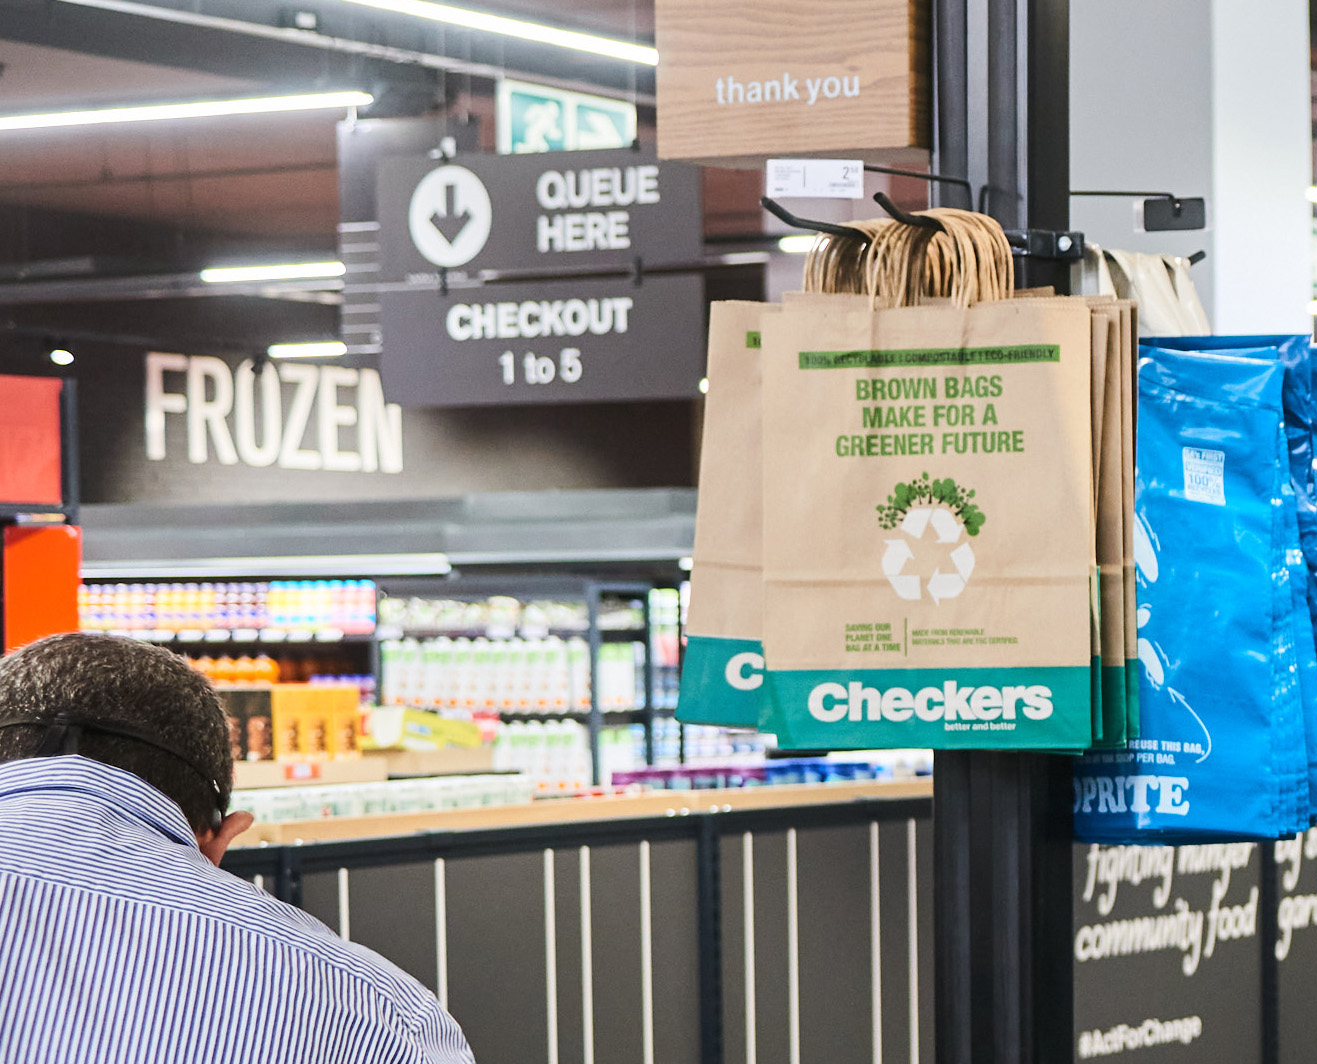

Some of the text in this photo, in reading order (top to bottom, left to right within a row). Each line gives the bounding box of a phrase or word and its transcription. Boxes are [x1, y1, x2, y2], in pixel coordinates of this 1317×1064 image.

[715, 72, 860, 105] thank you
[536, 166, 660, 209] QUEUE
[537, 211, 631, 252] HERE
[446, 297, 633, 340] CHECKOUT
[499, 348, 583, 385] 1 to 5
[856, 375, 1003, 401] BROWN BAGS
[146, 352, 403, 474] FROZEN
[862, 403, 998, 428] MAKE FOR A
[835, 430, 1025, 457] GREENER FUTURE
[807, 679, 1054, 723] Checkers
[944, 722, 1016, 732] better and better
[1129, 740, 1159, 751] REUSE
[1161, 741, 1181, 753] THIS
[1136, 753, 1155, 763] PER
[1075, 897, 1203, 976] community
[1204, 879, 1259, 958] food
[1078, 1016, 1202, 1058] #ActForChange
